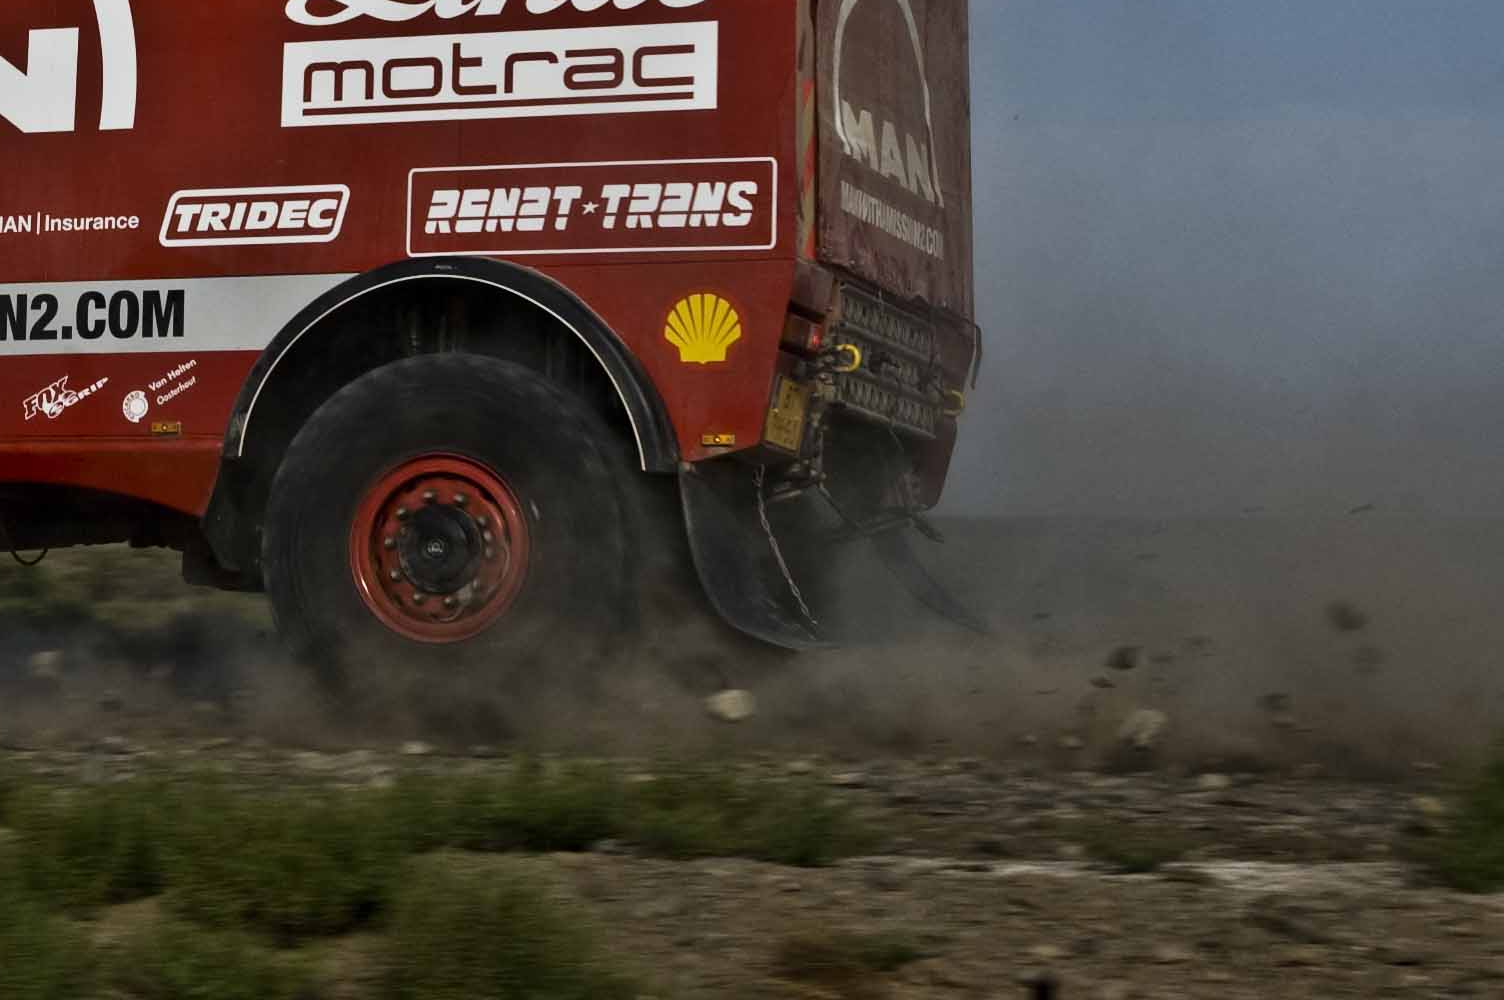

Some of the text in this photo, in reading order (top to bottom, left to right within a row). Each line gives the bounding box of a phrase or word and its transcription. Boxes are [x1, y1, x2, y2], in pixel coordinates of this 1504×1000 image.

[302, 43, 696, 103] motrac
[841, 99, 936, 203] MAN
[44, 213, 140, 233] Insurance
[175, 199, 338, 234] TRIDEC
[148, 376, 168, 393] Van
